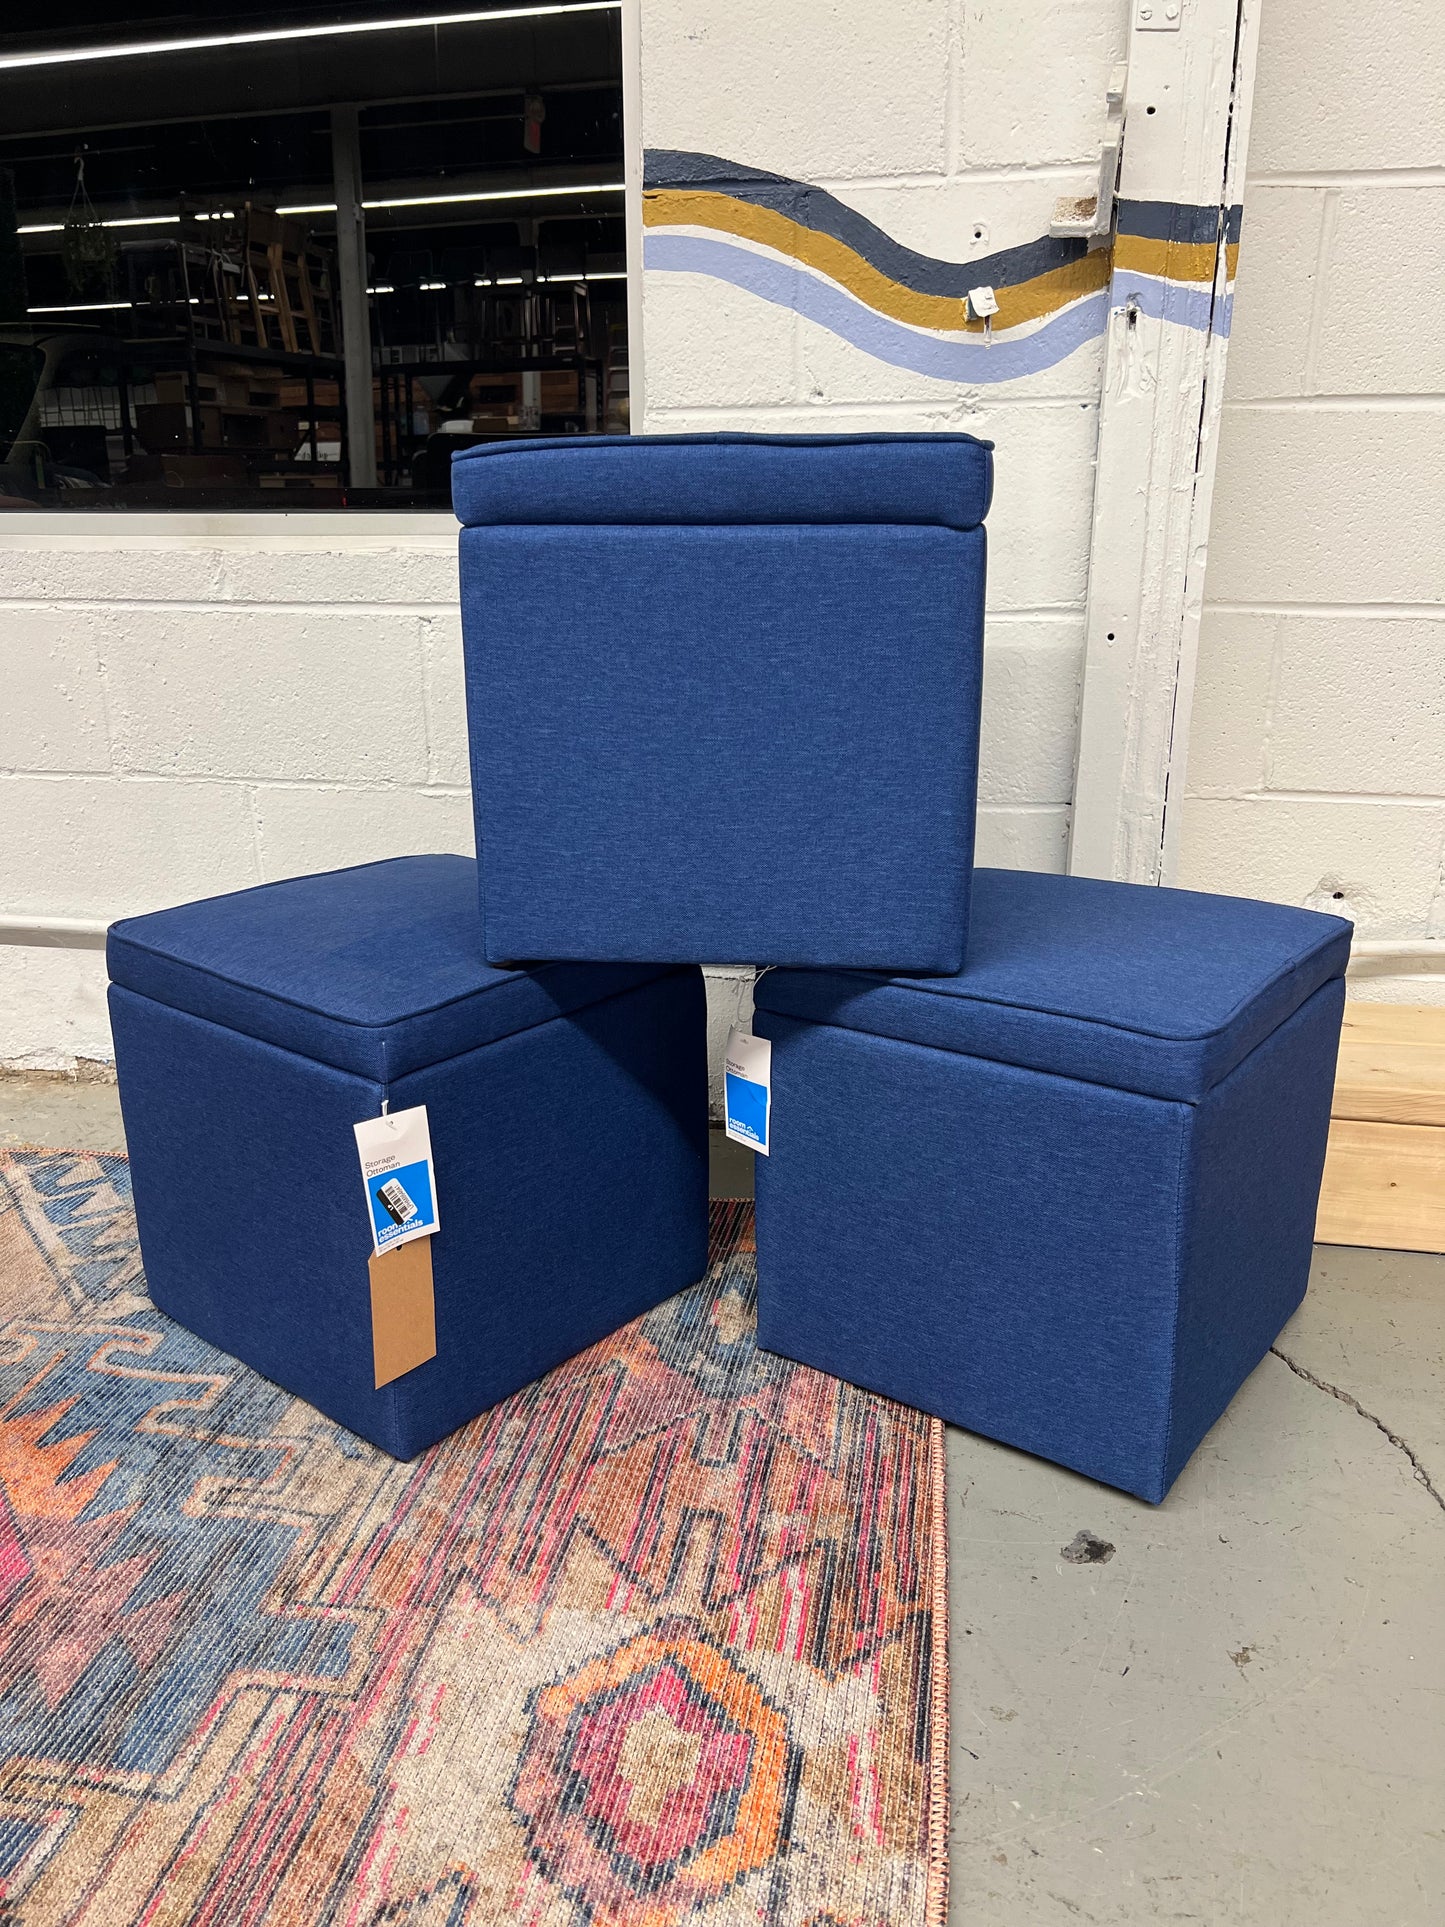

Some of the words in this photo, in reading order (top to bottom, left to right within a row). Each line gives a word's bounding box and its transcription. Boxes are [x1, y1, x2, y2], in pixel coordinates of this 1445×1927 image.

[729, 1117, 746, 1129] room
[729, 1123, 759, 1141] essentials
[365, 1155, 395, 1169] Storage
[366, 1161, 400, 1177] Ottoman
[379, 1219, 424, 1243] essentials
